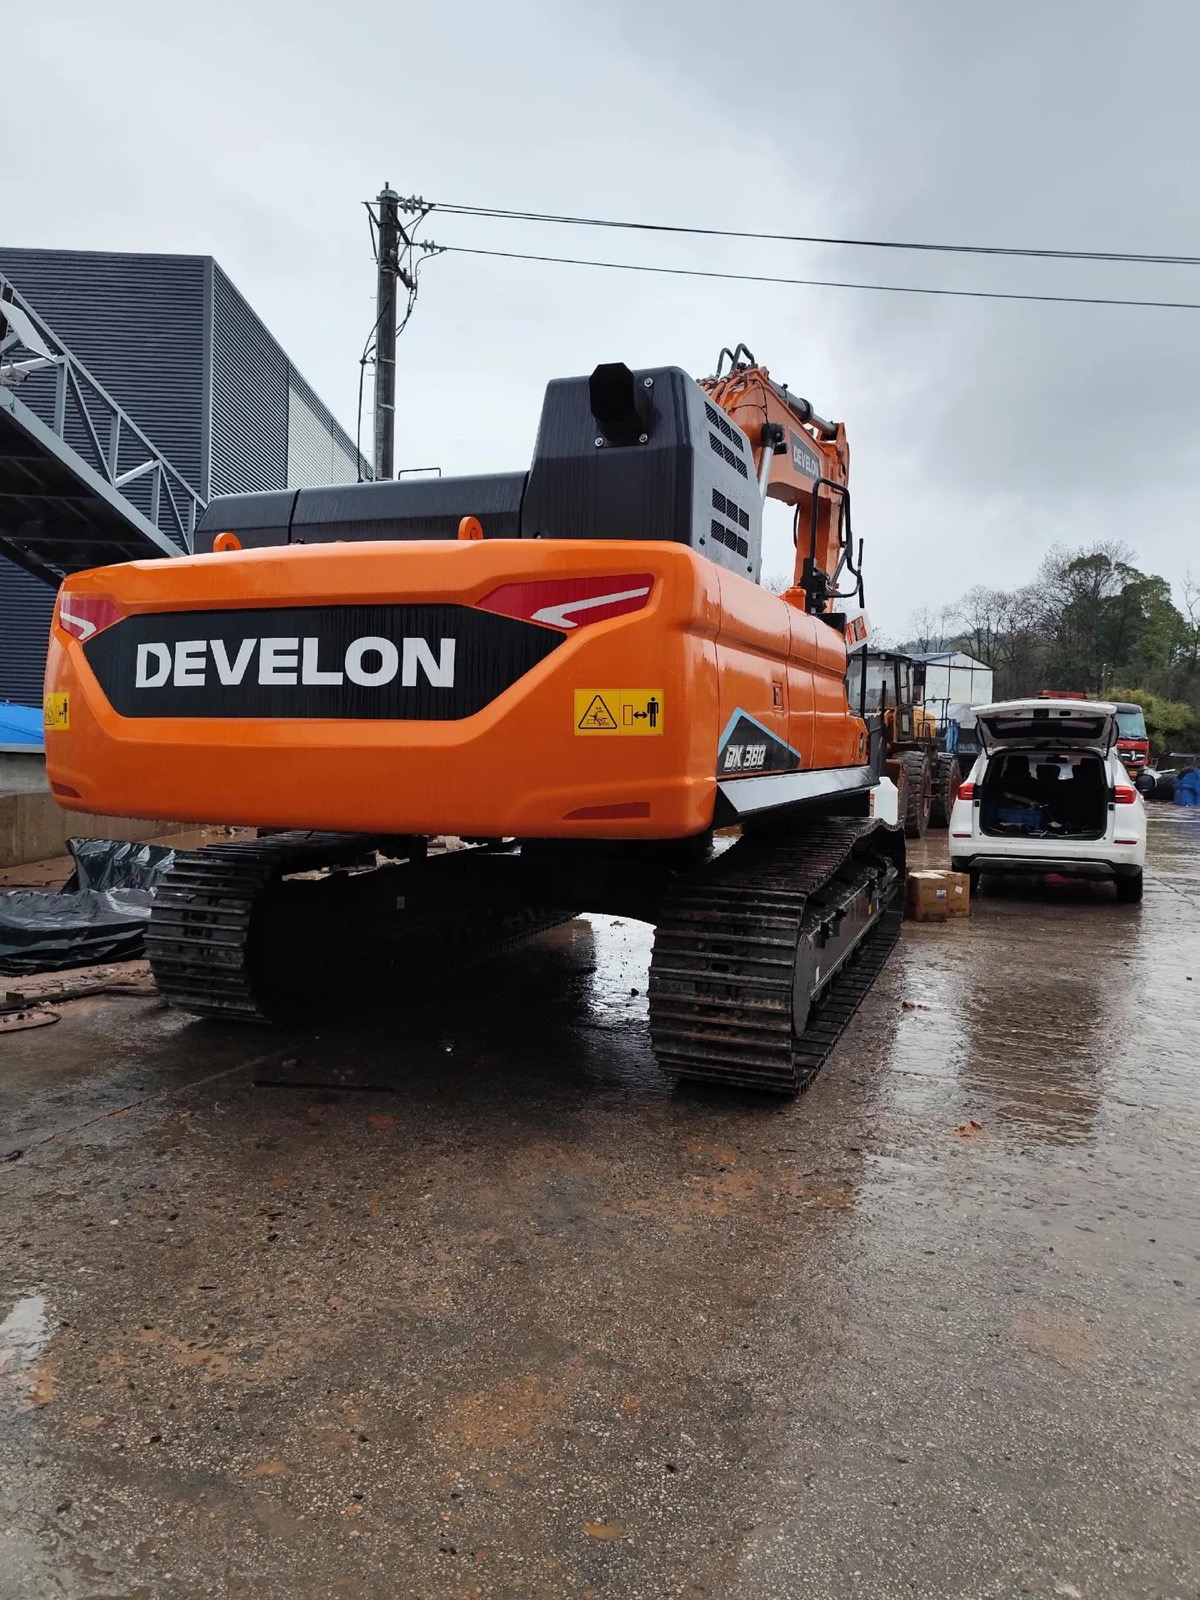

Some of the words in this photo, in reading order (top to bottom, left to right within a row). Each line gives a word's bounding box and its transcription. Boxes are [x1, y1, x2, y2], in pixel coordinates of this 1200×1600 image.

[793, 445, 819, 477] DEVELON
[136, 636, 456, 688] DEVELON
[743, 745, 766, 769] 380
